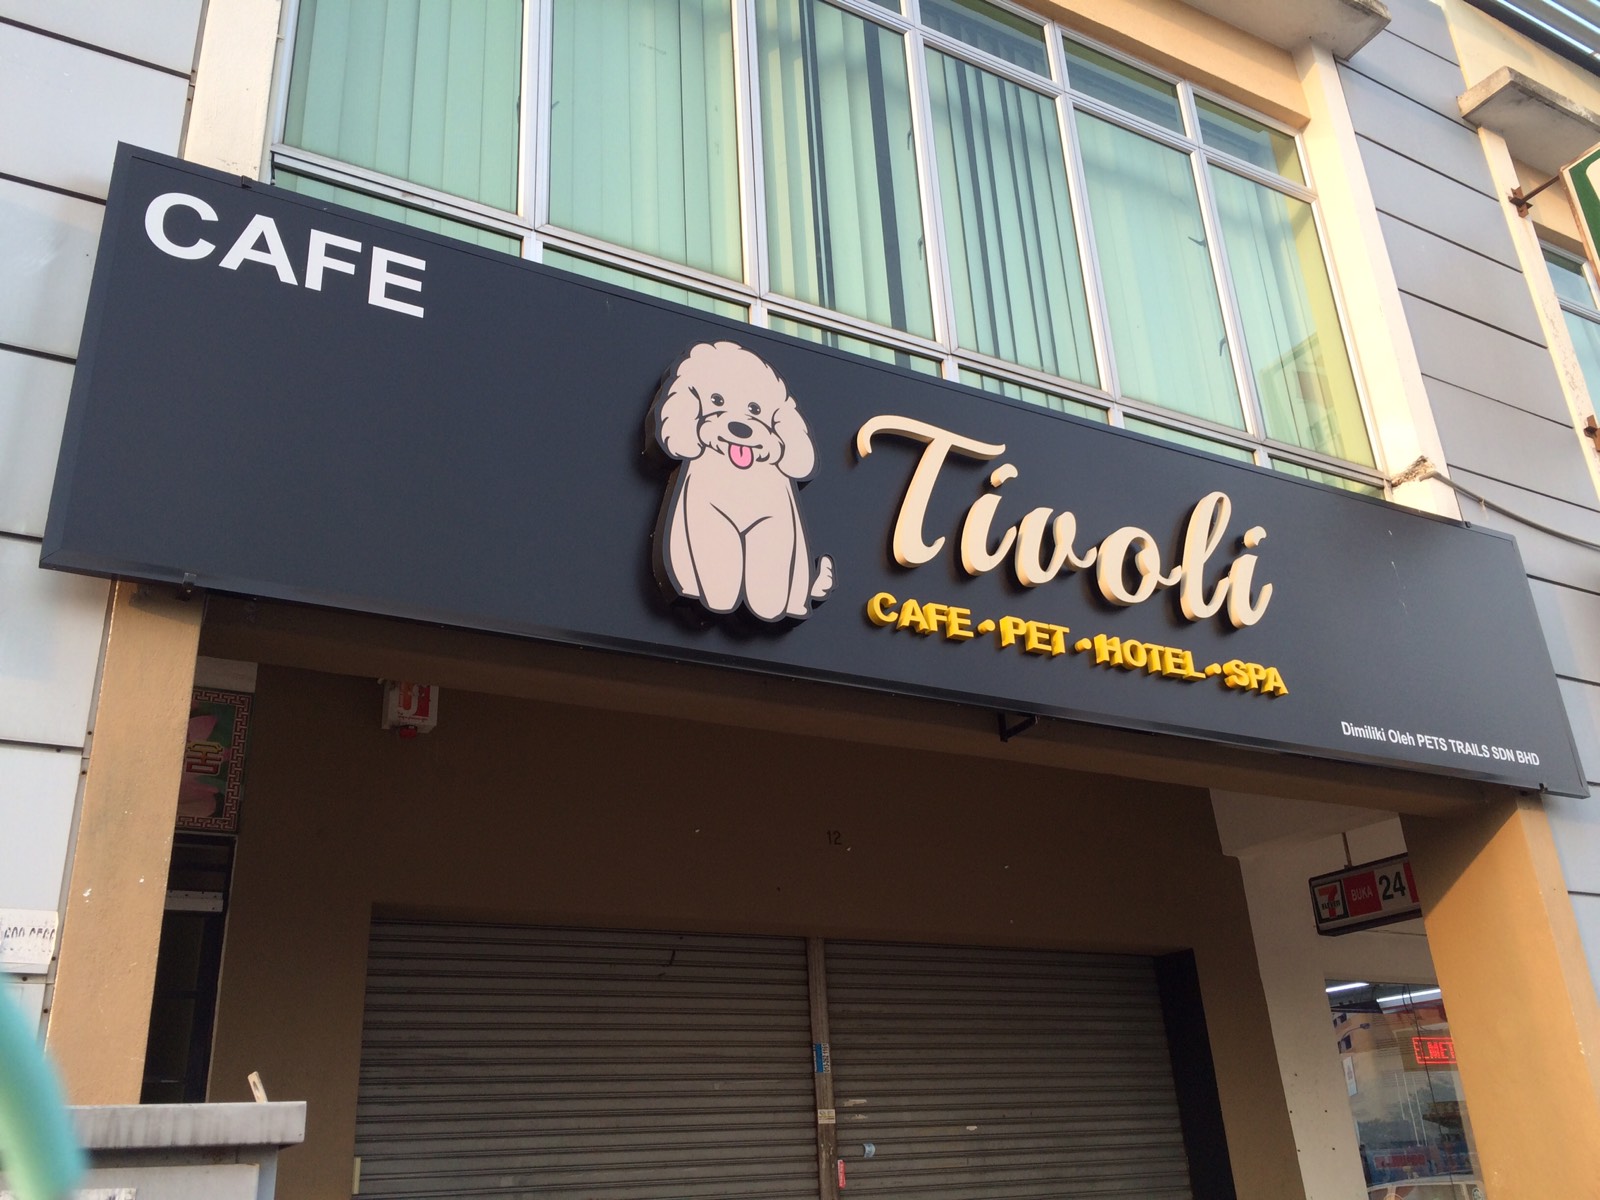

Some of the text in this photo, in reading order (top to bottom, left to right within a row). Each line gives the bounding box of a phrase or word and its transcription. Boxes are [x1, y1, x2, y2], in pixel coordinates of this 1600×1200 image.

[145, 192, 426, 318] CAFE
[857, 415, 1273, 629] Tivoli
[867, 592, 1289, 697] CAFE PET HOTEL SPA
[1341, 721, 1540, 766] Dimiliki Oleh PETS TRAILS SDN BHD
[827, 830, 842, 845] 12
[1351, 871, 1406, 901] BUKA 24
